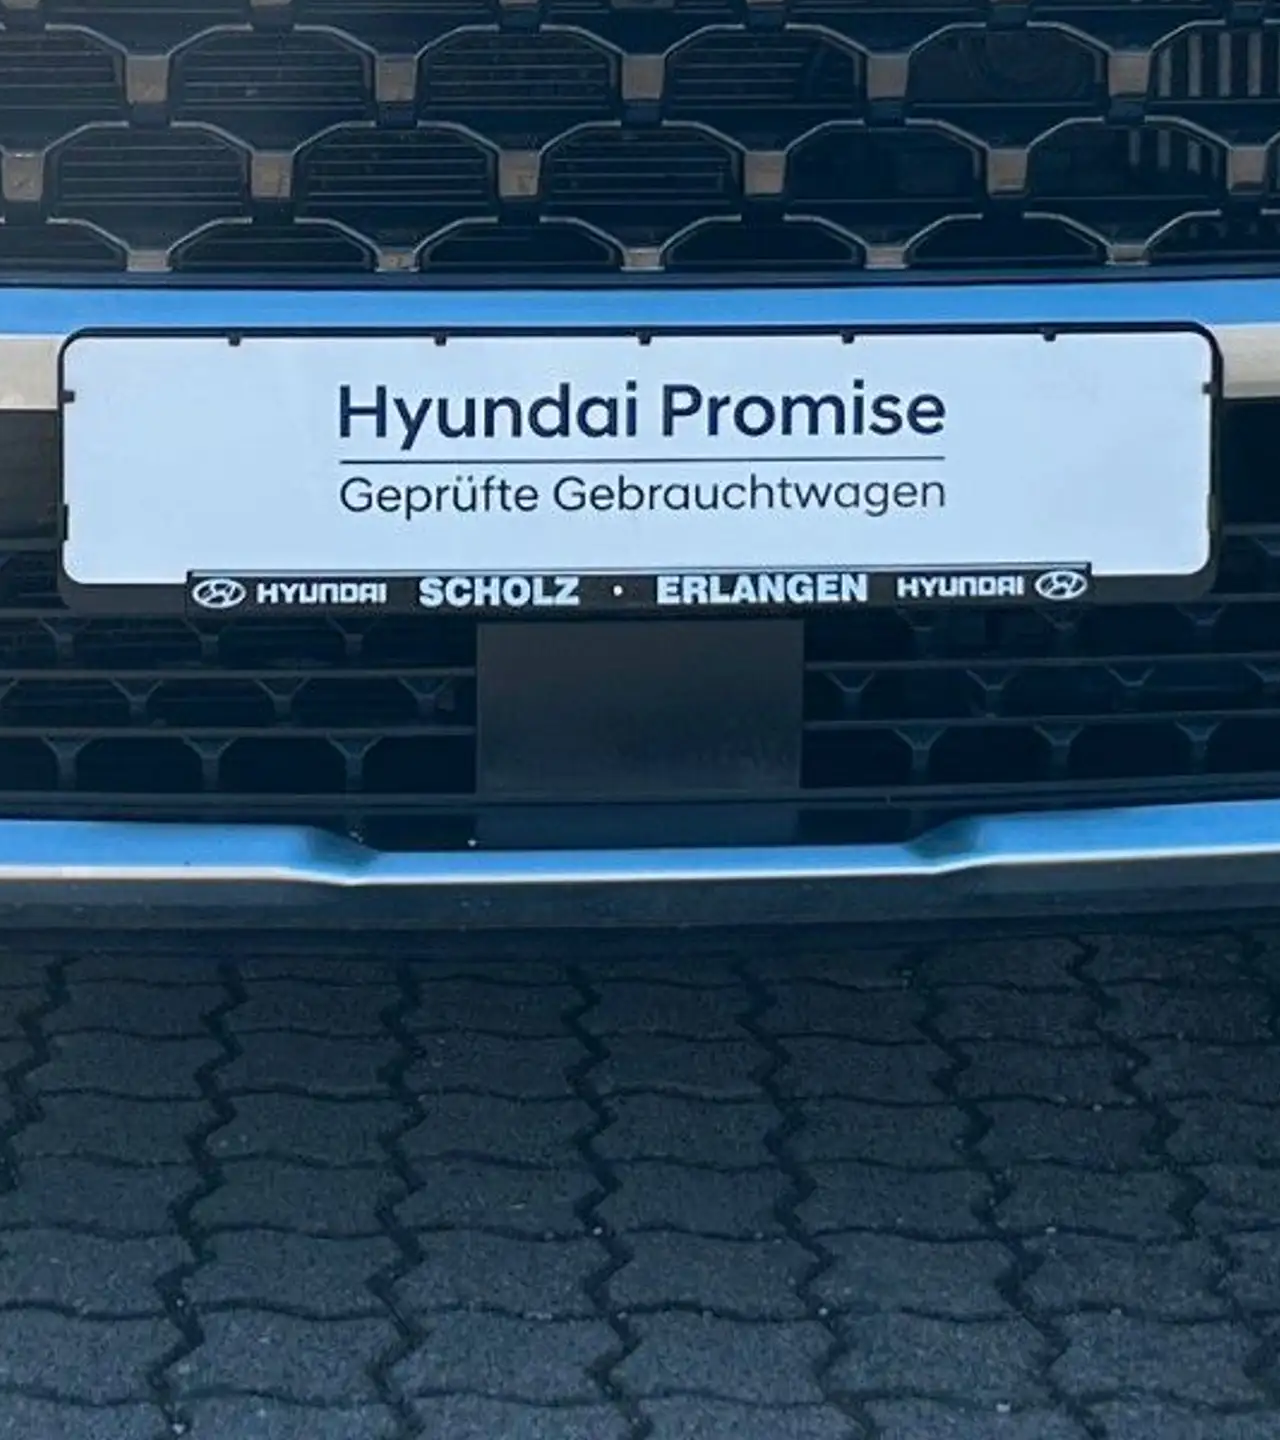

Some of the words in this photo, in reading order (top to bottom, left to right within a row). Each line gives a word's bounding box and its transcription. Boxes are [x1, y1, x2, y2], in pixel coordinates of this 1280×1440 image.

[339, 379, 638, 452] Hyundai
[662, 378, 947, 439] Promise
[339, 474, 540, 523] Geprüfte
[552, 473, 947, 519] Gebrauchtwagen
[256, 581, 388, 605] HYUNDAI
[418, 574, 581, 608] SCHOLZ
[655, 572, 869, 606] ERLANGEN
[896, 576, 1026, 599] HYUNDAI
